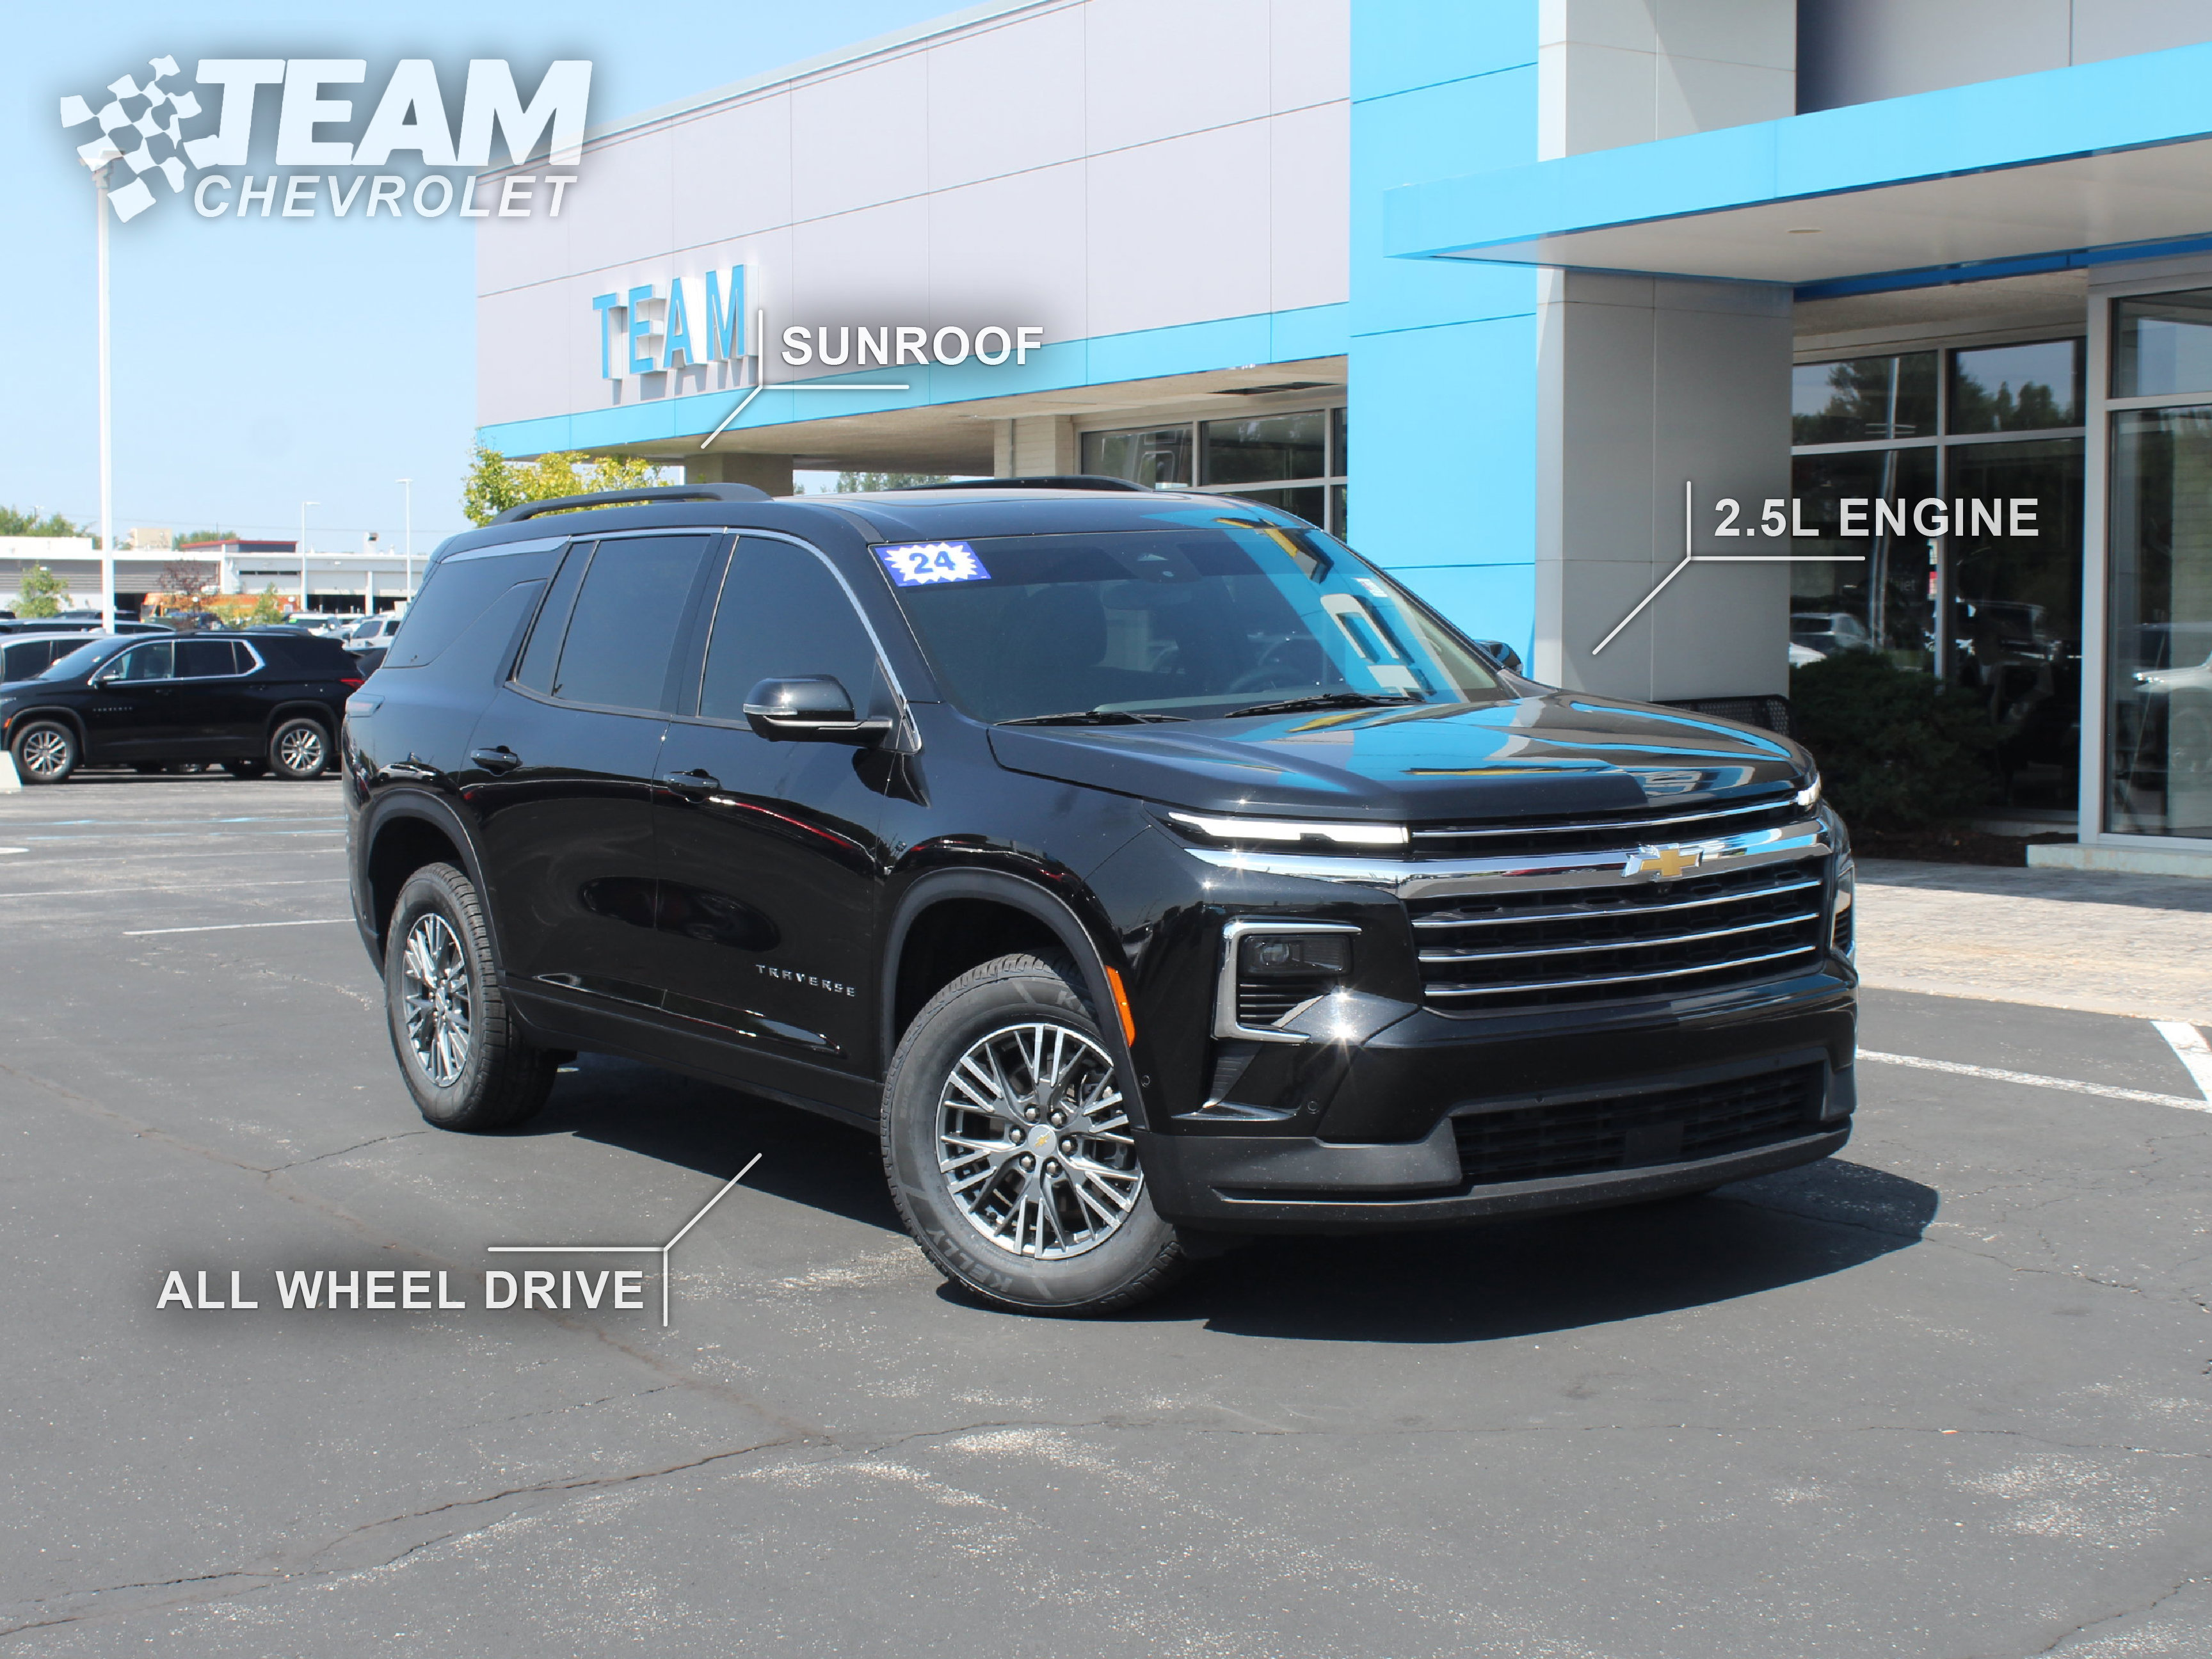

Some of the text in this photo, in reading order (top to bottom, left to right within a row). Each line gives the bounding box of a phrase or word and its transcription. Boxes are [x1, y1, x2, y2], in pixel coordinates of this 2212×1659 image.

[593, 264, 749, 380] TEAM
[909, 550, 956, 574] 24
[755, 964, 856, 997] TRAVERSE
[926, 1228, 1014, 1293] KELLY
